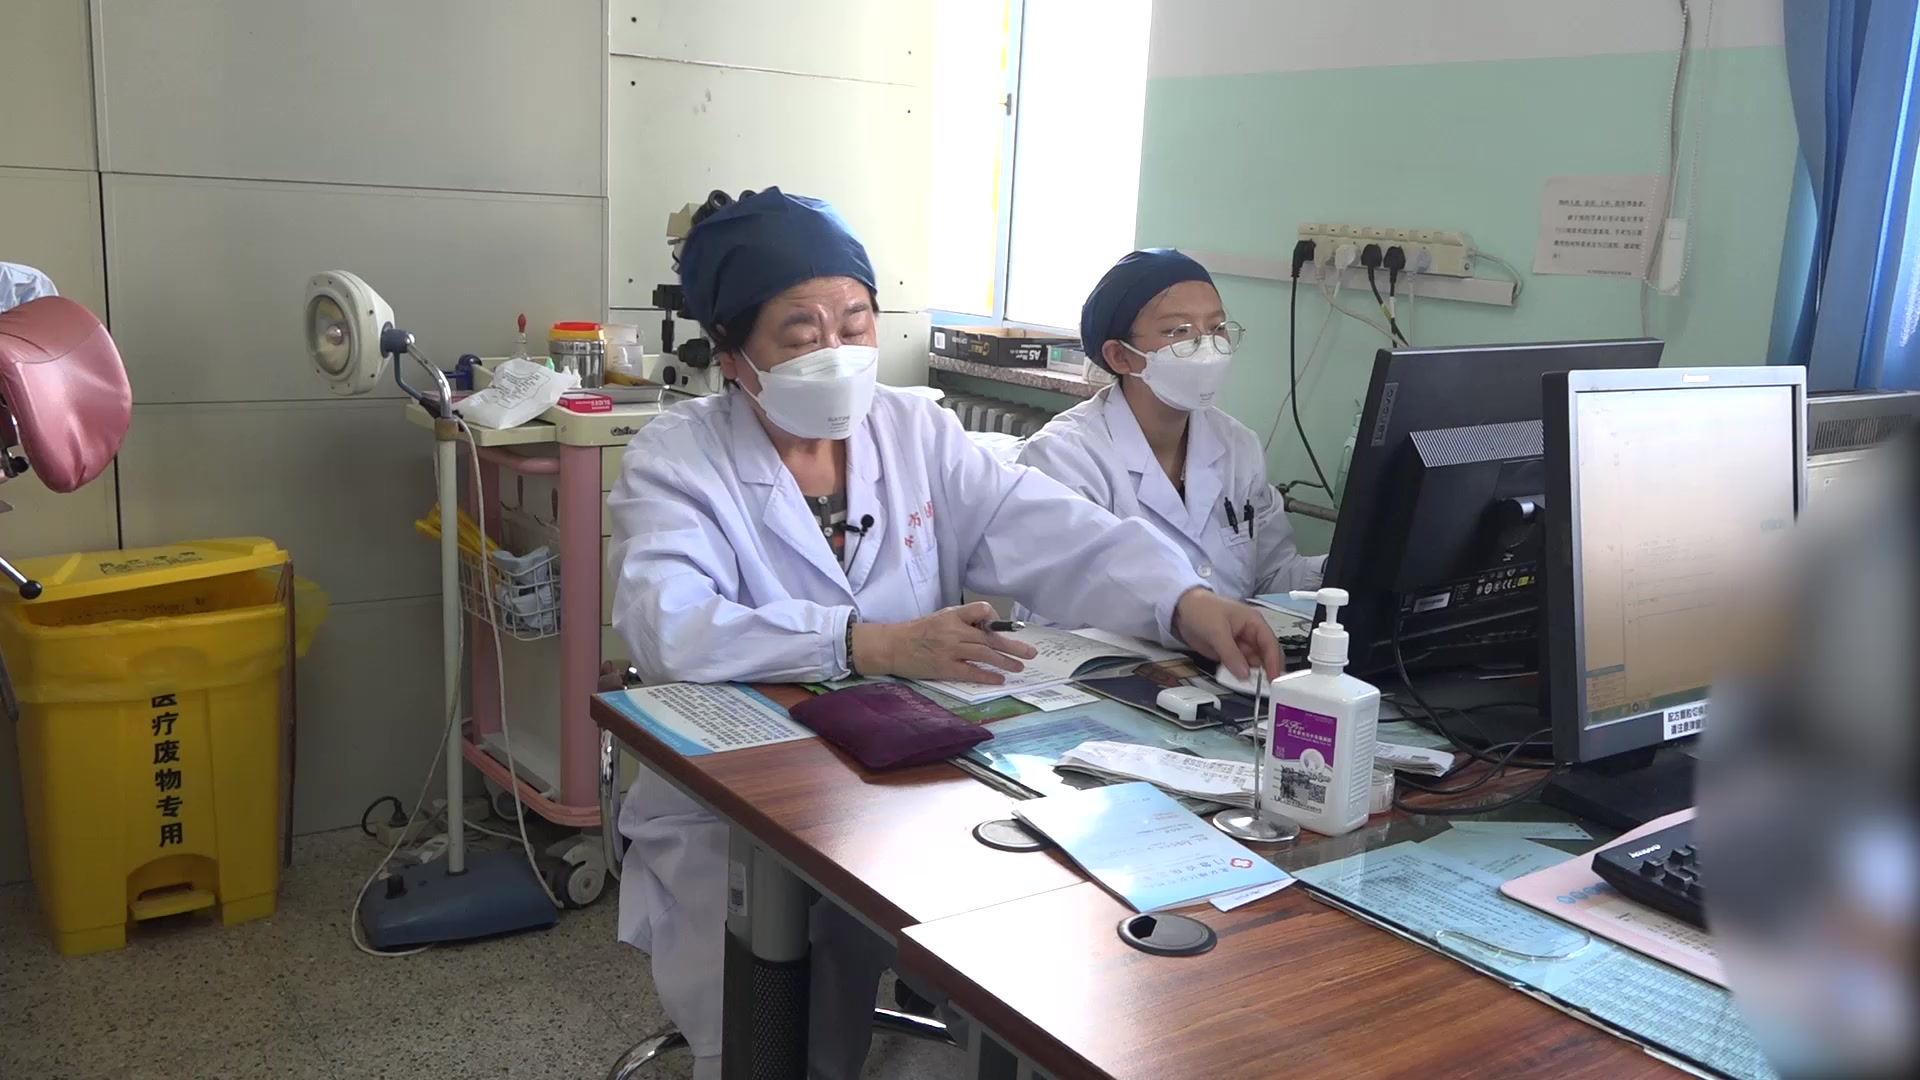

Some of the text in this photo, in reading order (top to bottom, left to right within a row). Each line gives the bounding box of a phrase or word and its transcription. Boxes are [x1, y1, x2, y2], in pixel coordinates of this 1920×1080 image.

[151, 693, 184, 847] 医疗废物专用
